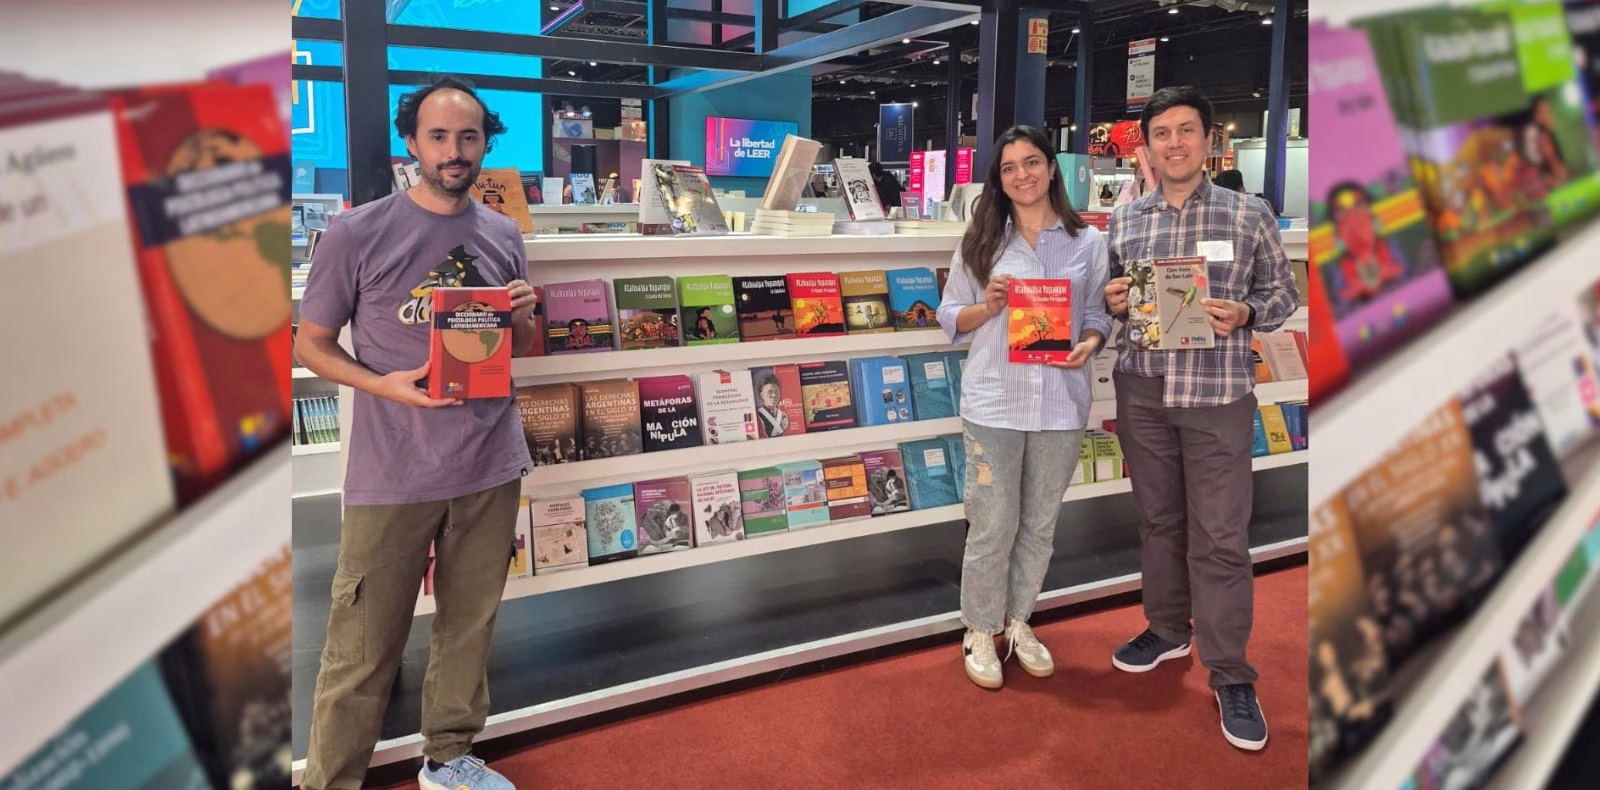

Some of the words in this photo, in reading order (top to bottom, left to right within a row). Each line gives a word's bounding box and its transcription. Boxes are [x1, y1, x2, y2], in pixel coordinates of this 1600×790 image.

[730, 137, 741, 147] La
[742, 137, 775, 149] libertad
[734, 147, 746, 158] de
[746, 149, 771, 159] LEER
[600, 392, 635, 400] DERECHAS
[519, 400, 529, 408] AS
[531, 398, 568, 407] DERECHAS
[586, 399, 636, 409] ARGENTINAS
[643, 396, 692, 407] METÁFORAS
[538, 413, 559, 421] SIGLO
